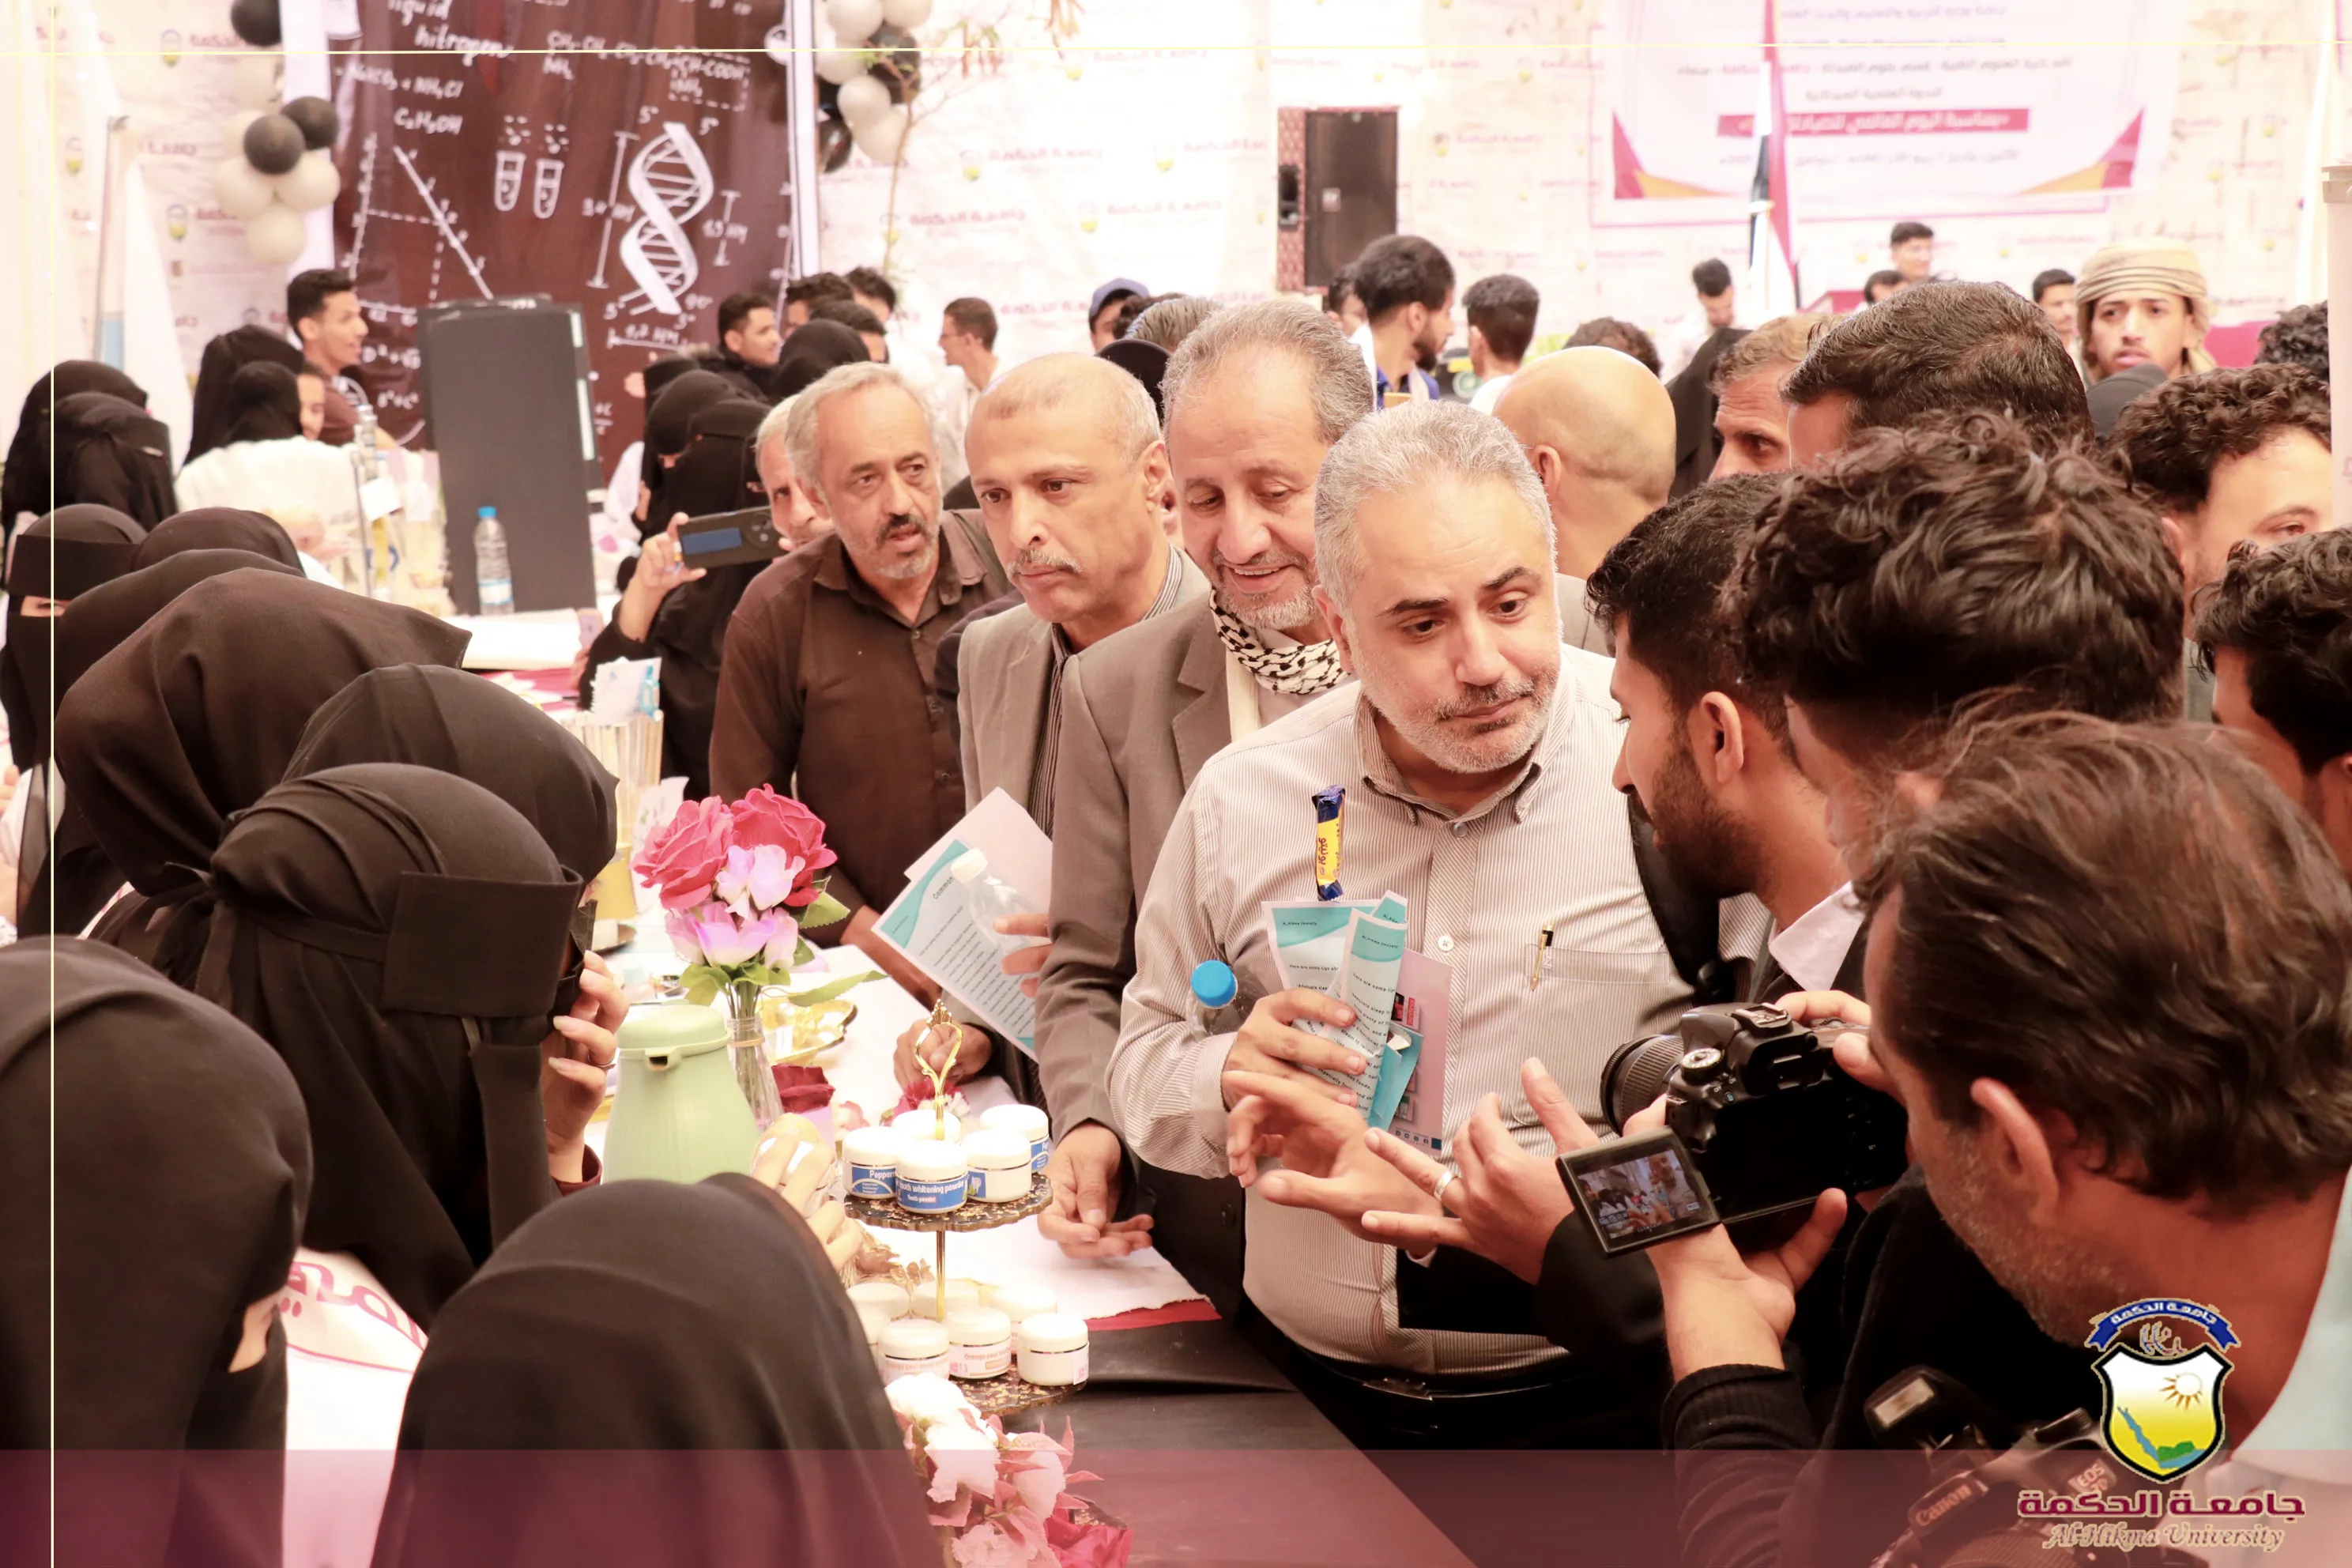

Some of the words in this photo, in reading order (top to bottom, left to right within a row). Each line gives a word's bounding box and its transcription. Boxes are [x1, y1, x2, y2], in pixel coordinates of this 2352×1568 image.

[1370, 1006, 1385, 1015] sleep
[912, 1185, 944, 1195] whitening
[2077, 1464, 2105, 1487] EOS
[1915, 1484, 1973, 1527] Canon
